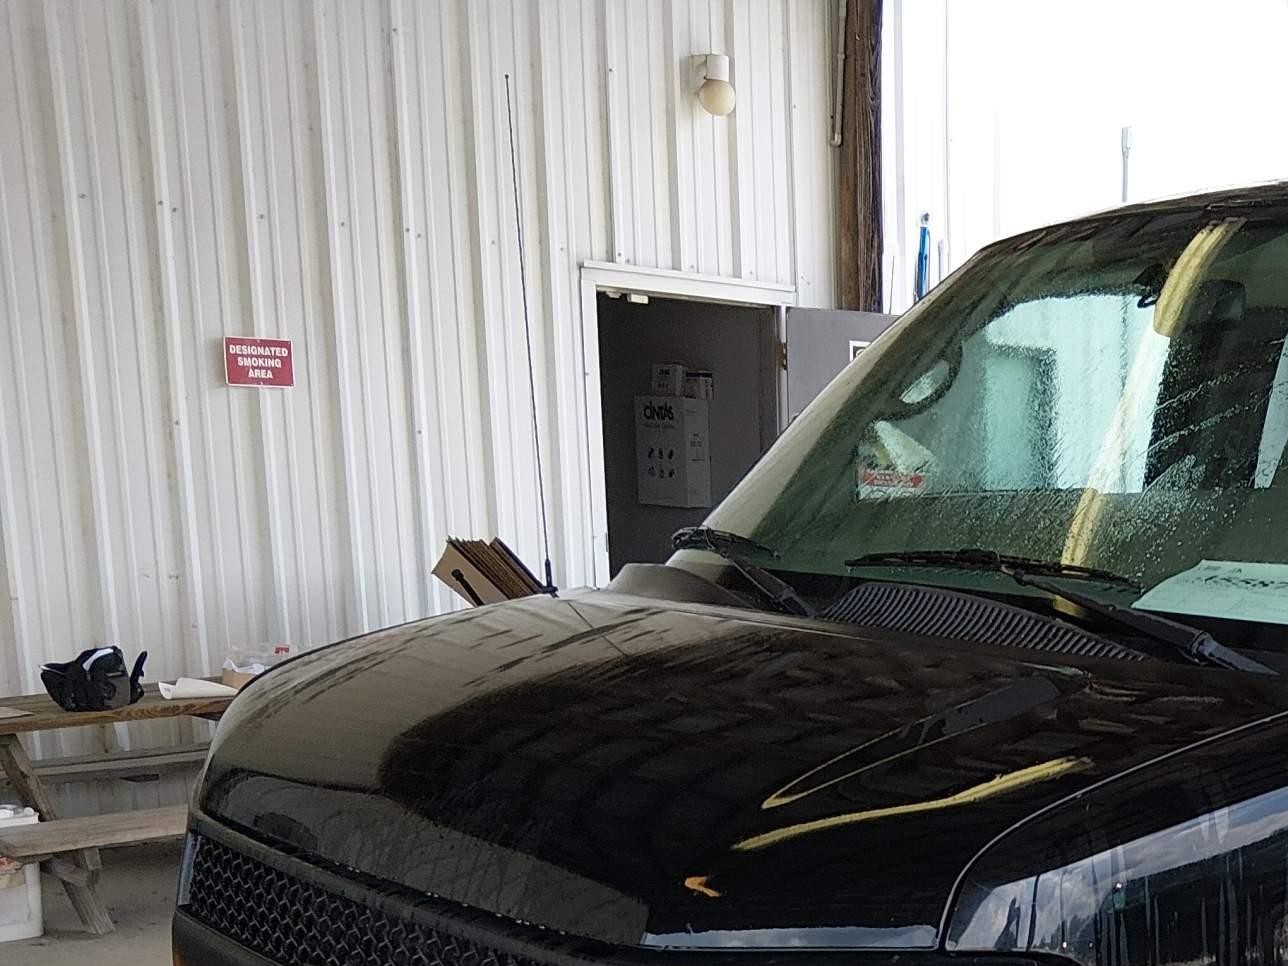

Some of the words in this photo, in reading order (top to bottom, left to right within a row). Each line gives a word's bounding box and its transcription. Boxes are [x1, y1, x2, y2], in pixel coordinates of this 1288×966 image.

[229, 344, 288, 357] DESIGNATED
[238, 356, 281, 368] SMOKING
[248, 369, 273, 379] AREA
